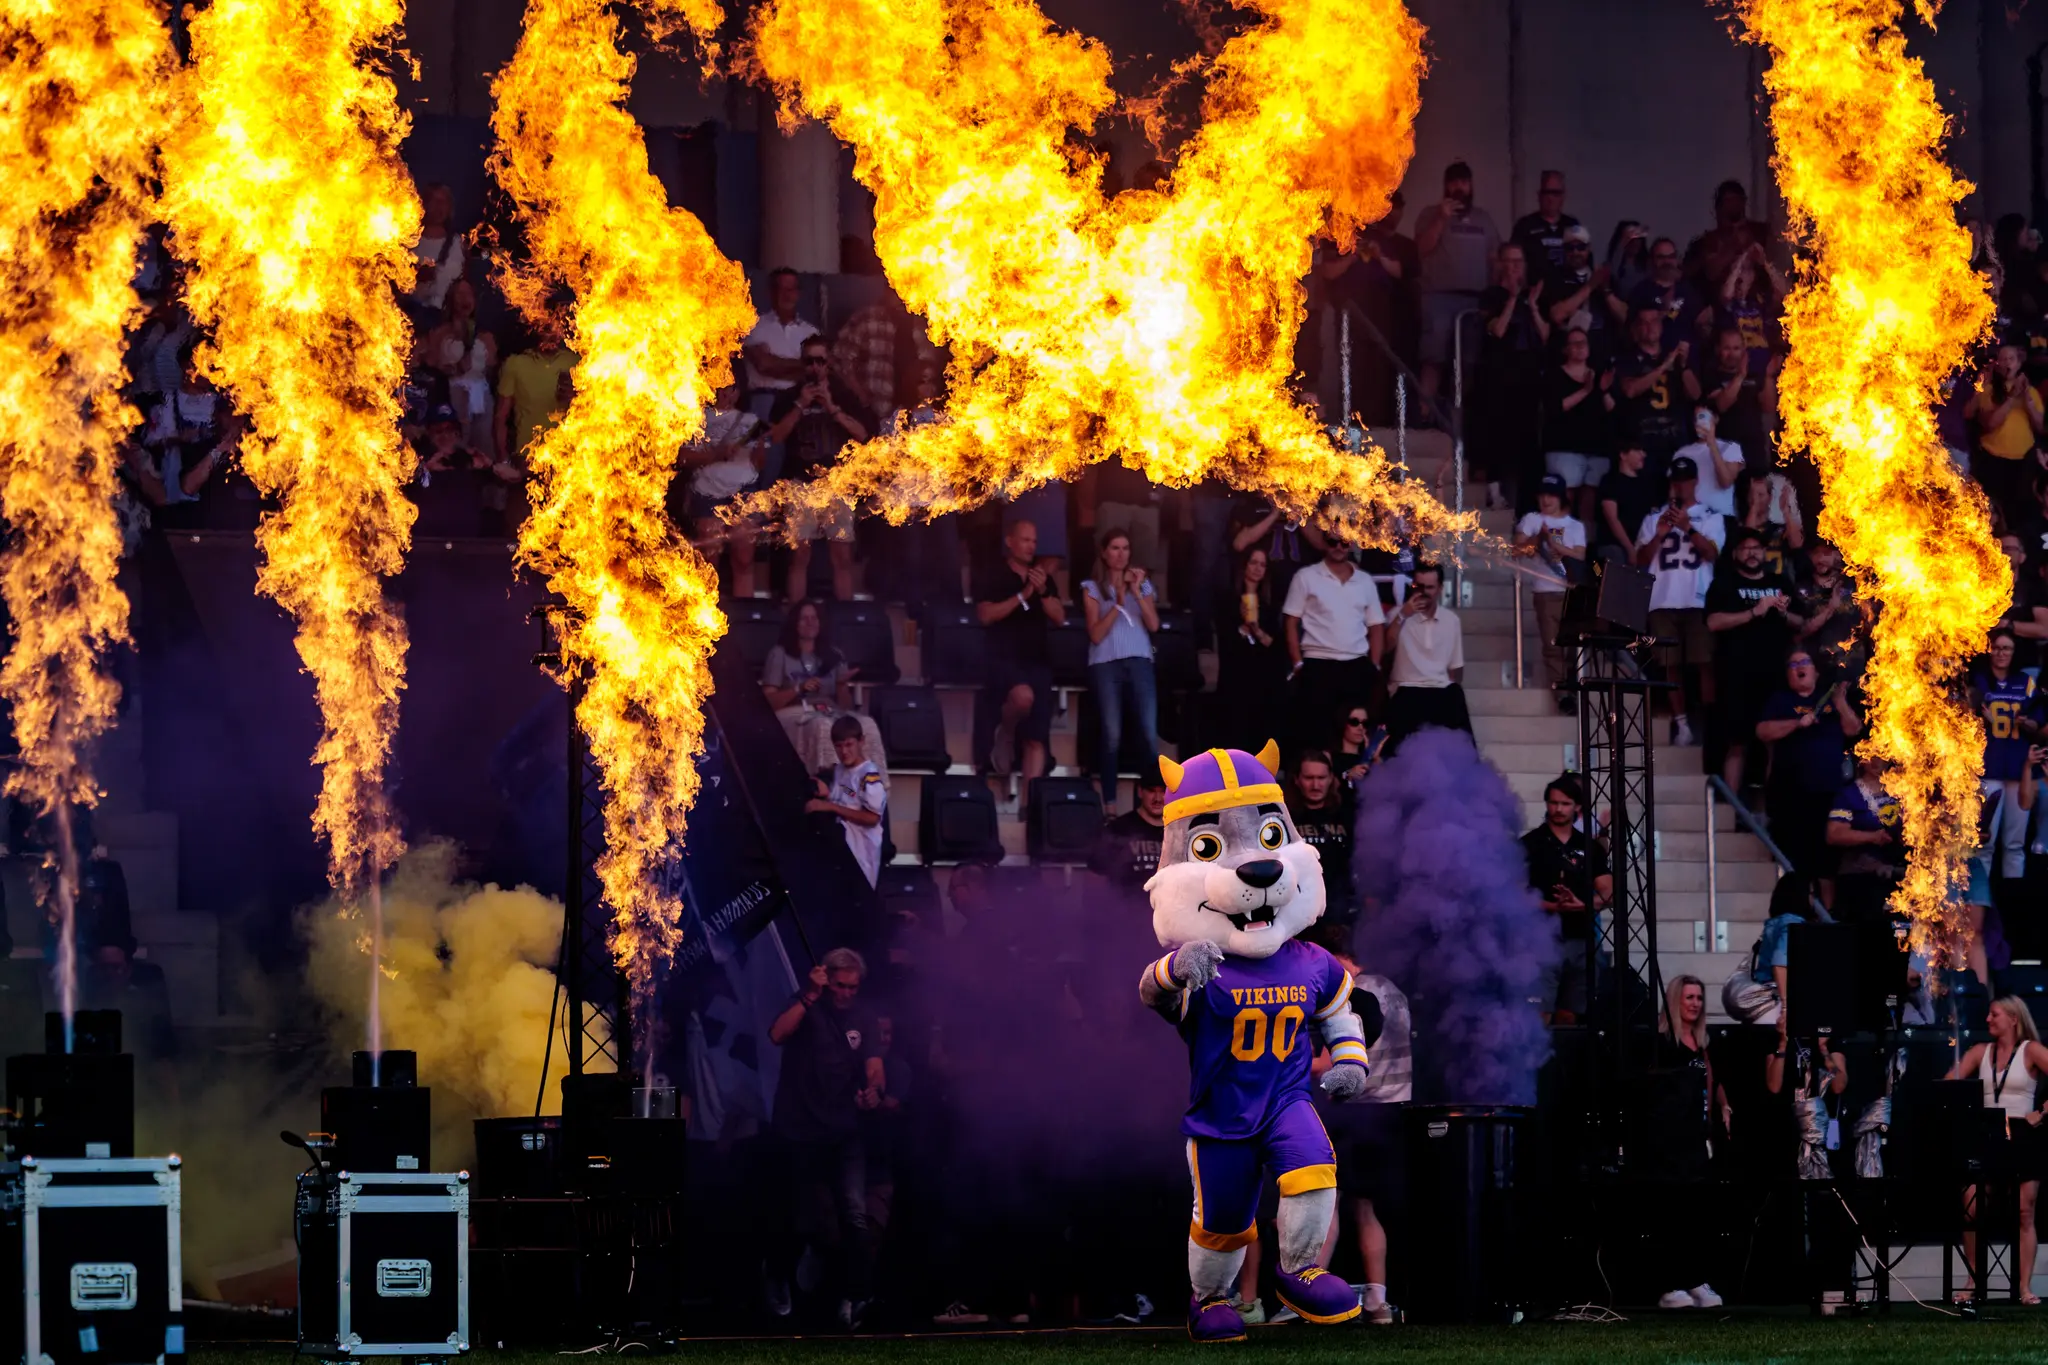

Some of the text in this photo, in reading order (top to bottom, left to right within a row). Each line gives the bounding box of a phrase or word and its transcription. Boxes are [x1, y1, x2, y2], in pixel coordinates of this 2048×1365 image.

[1649, 375, 1670, 410] 5
[1659, 531, 1702, 571] 23
[1990, 700, 2022, 740] 61
[1230, 985, 1308, 1006] VIKINGS
[1230, 1005, 1306, 1064] 00
